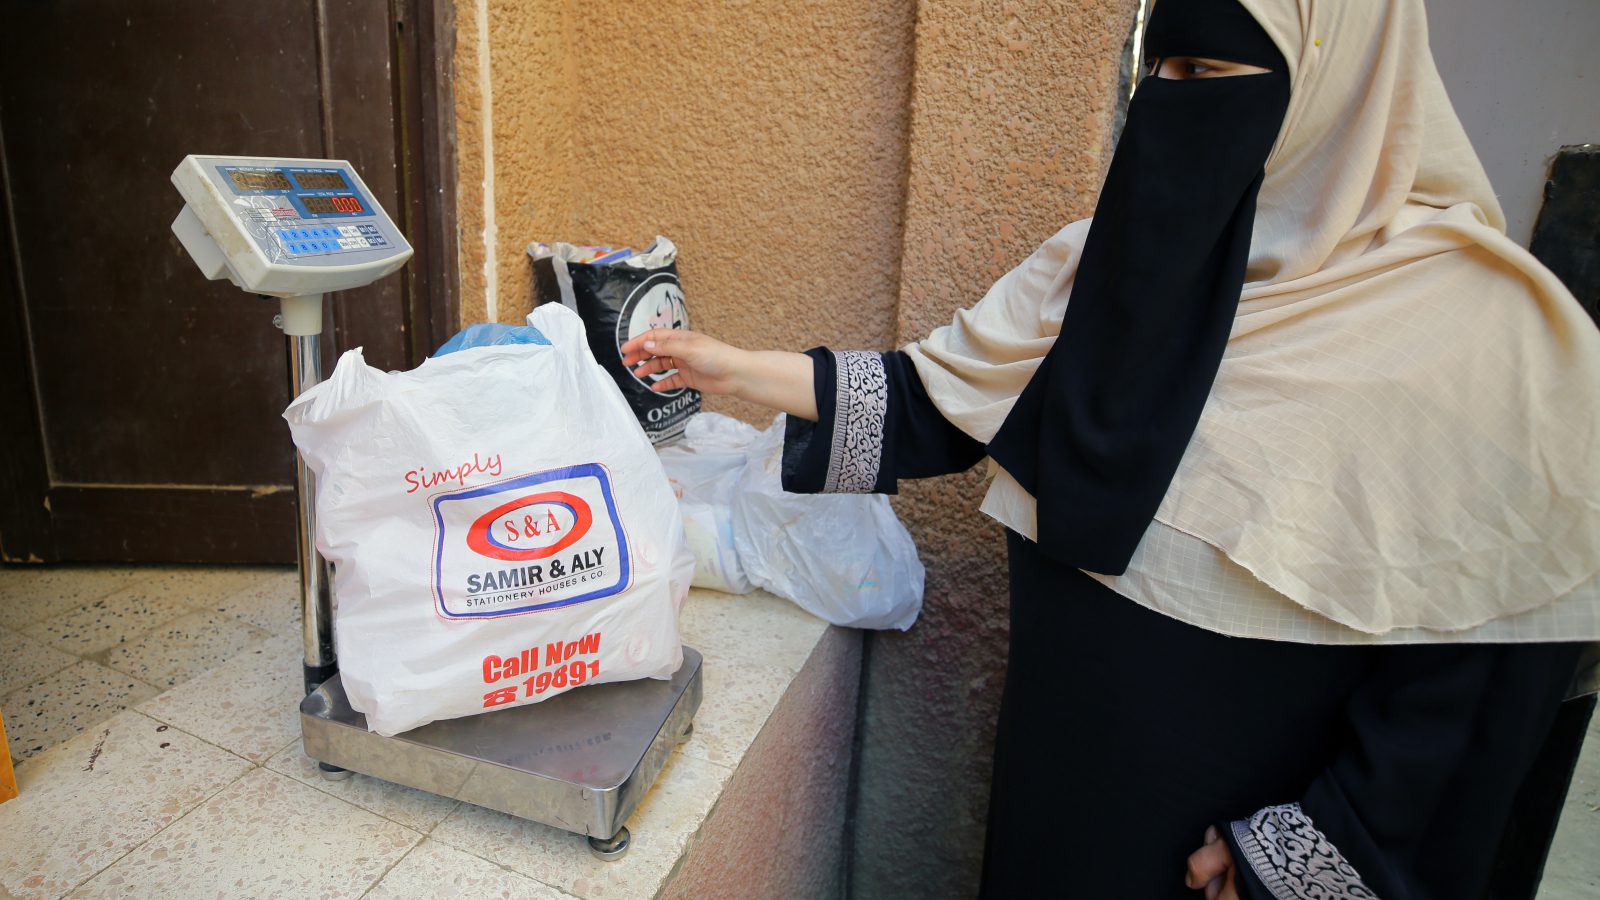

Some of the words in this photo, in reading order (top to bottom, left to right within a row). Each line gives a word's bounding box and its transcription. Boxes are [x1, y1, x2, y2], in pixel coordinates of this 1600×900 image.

[404, 452, 502, 493] Simply
[504, 520, 520, 542] S
[523, 514, 541, 538] &
[546, 508, 561, 534] A
[466, 565, 543, 594] SAMIR
[549, 559, 565, 579] &
[571, 547, 605, 573] ALY
[466, 590, 535, 607] STATIONERY
[539, 577, 578, 596] HOUSES
[581, 575, 587, 583] &
[482, 646, 539, 684] Call
[523, 659, 600, 698] 19891
